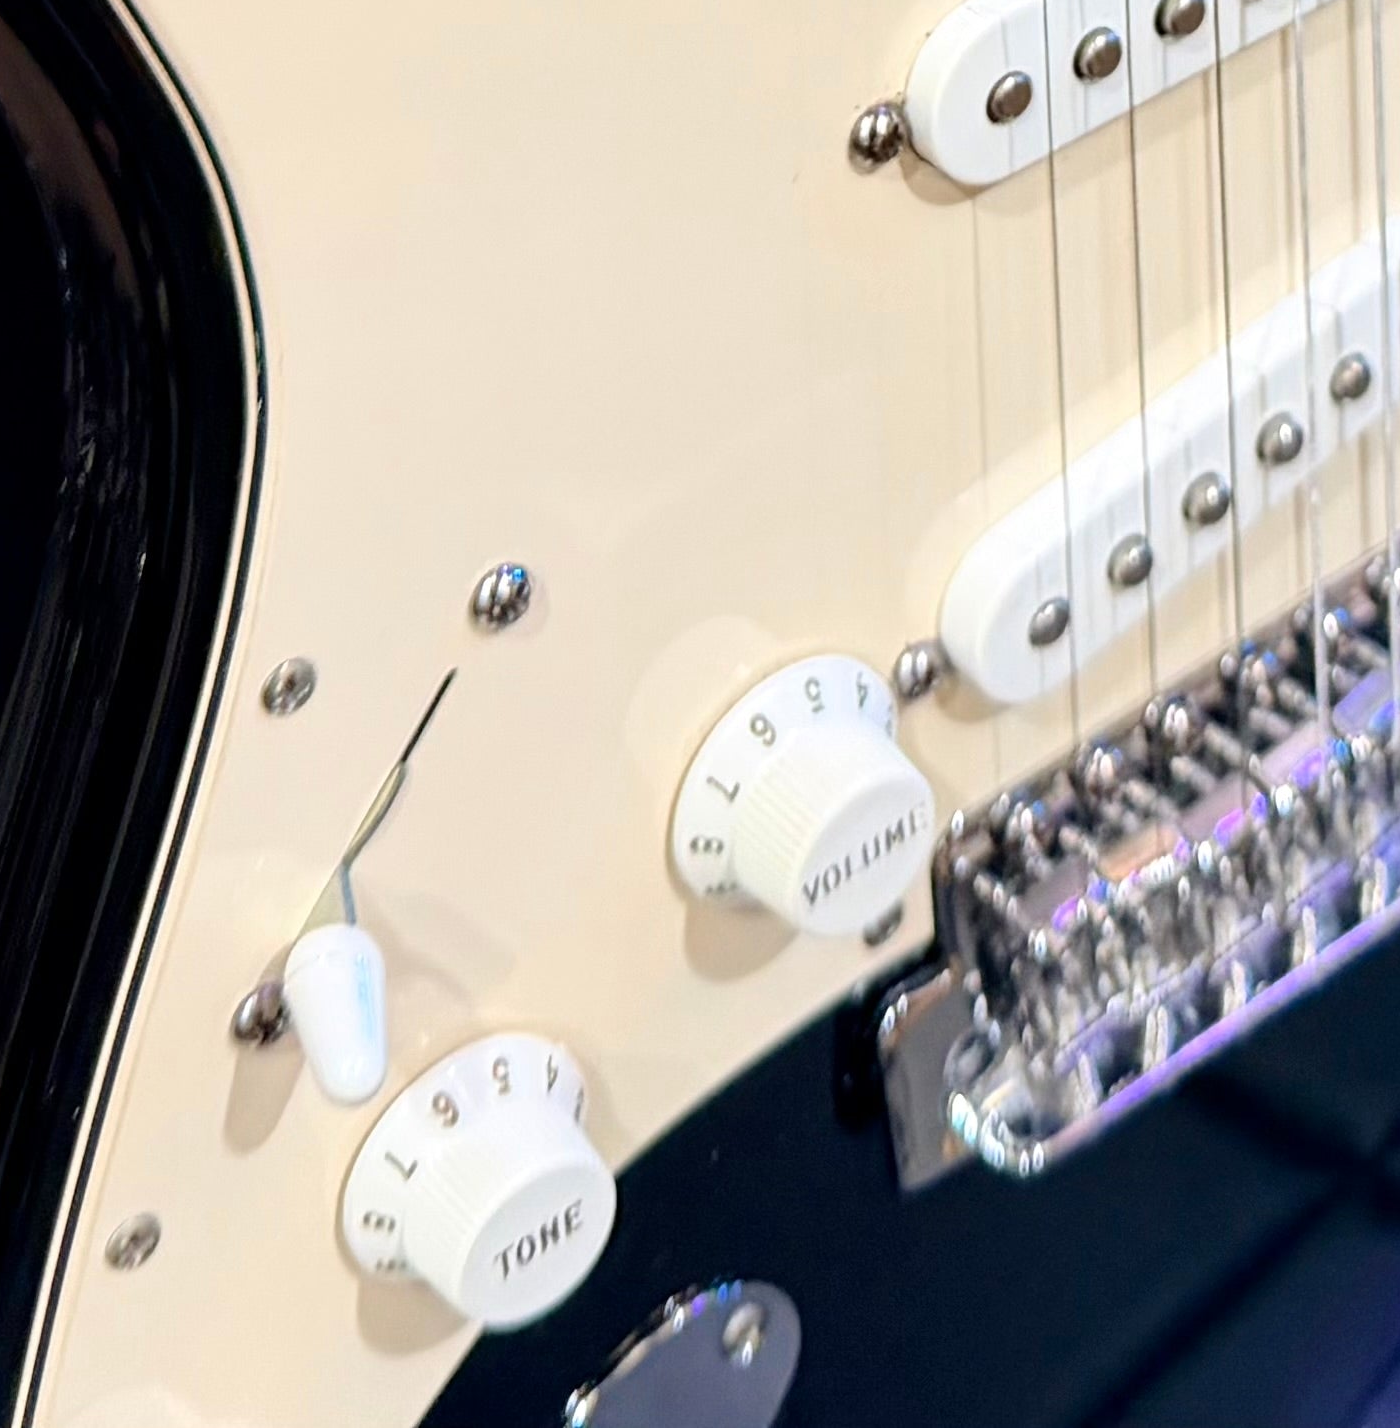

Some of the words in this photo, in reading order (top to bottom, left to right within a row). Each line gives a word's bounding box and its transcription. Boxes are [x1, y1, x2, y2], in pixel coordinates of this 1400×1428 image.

[749, 712, 777, 747] 6
[706, 776, 740, 803] 7
[800, 800, 929, 907] VOLUME
[431, 1090, 460, 1128] 6
[384, 1150, 418, 1181] 7
[494, 1199, 585, 1280] TONE
